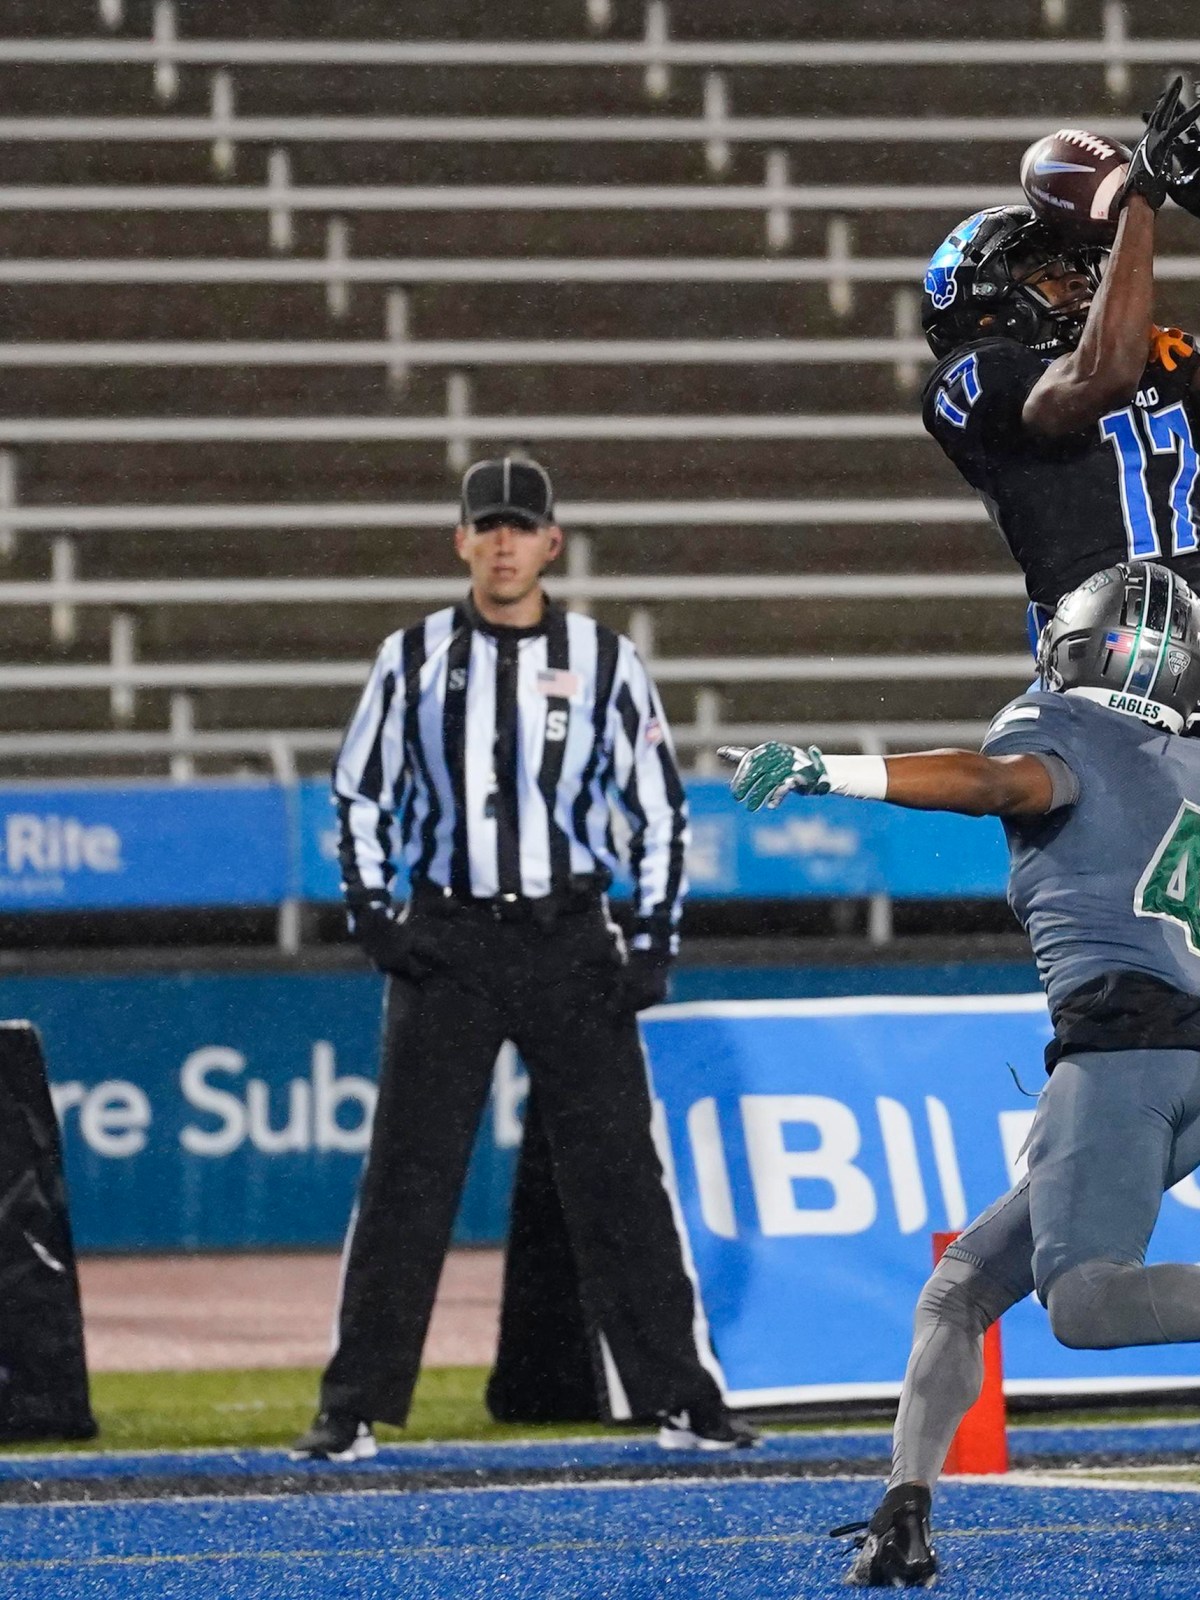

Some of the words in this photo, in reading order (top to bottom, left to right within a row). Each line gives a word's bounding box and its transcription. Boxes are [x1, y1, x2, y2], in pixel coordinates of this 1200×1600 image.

[933, 351, 984, 430] 17
[1098, 400, 1200, 561] 17
[449, 668, 466, 690] S
[547, 711, 567, 741] S
[1108, 694, 1161, 719] EAGLES
[50, 1079, 151, 1158] re
